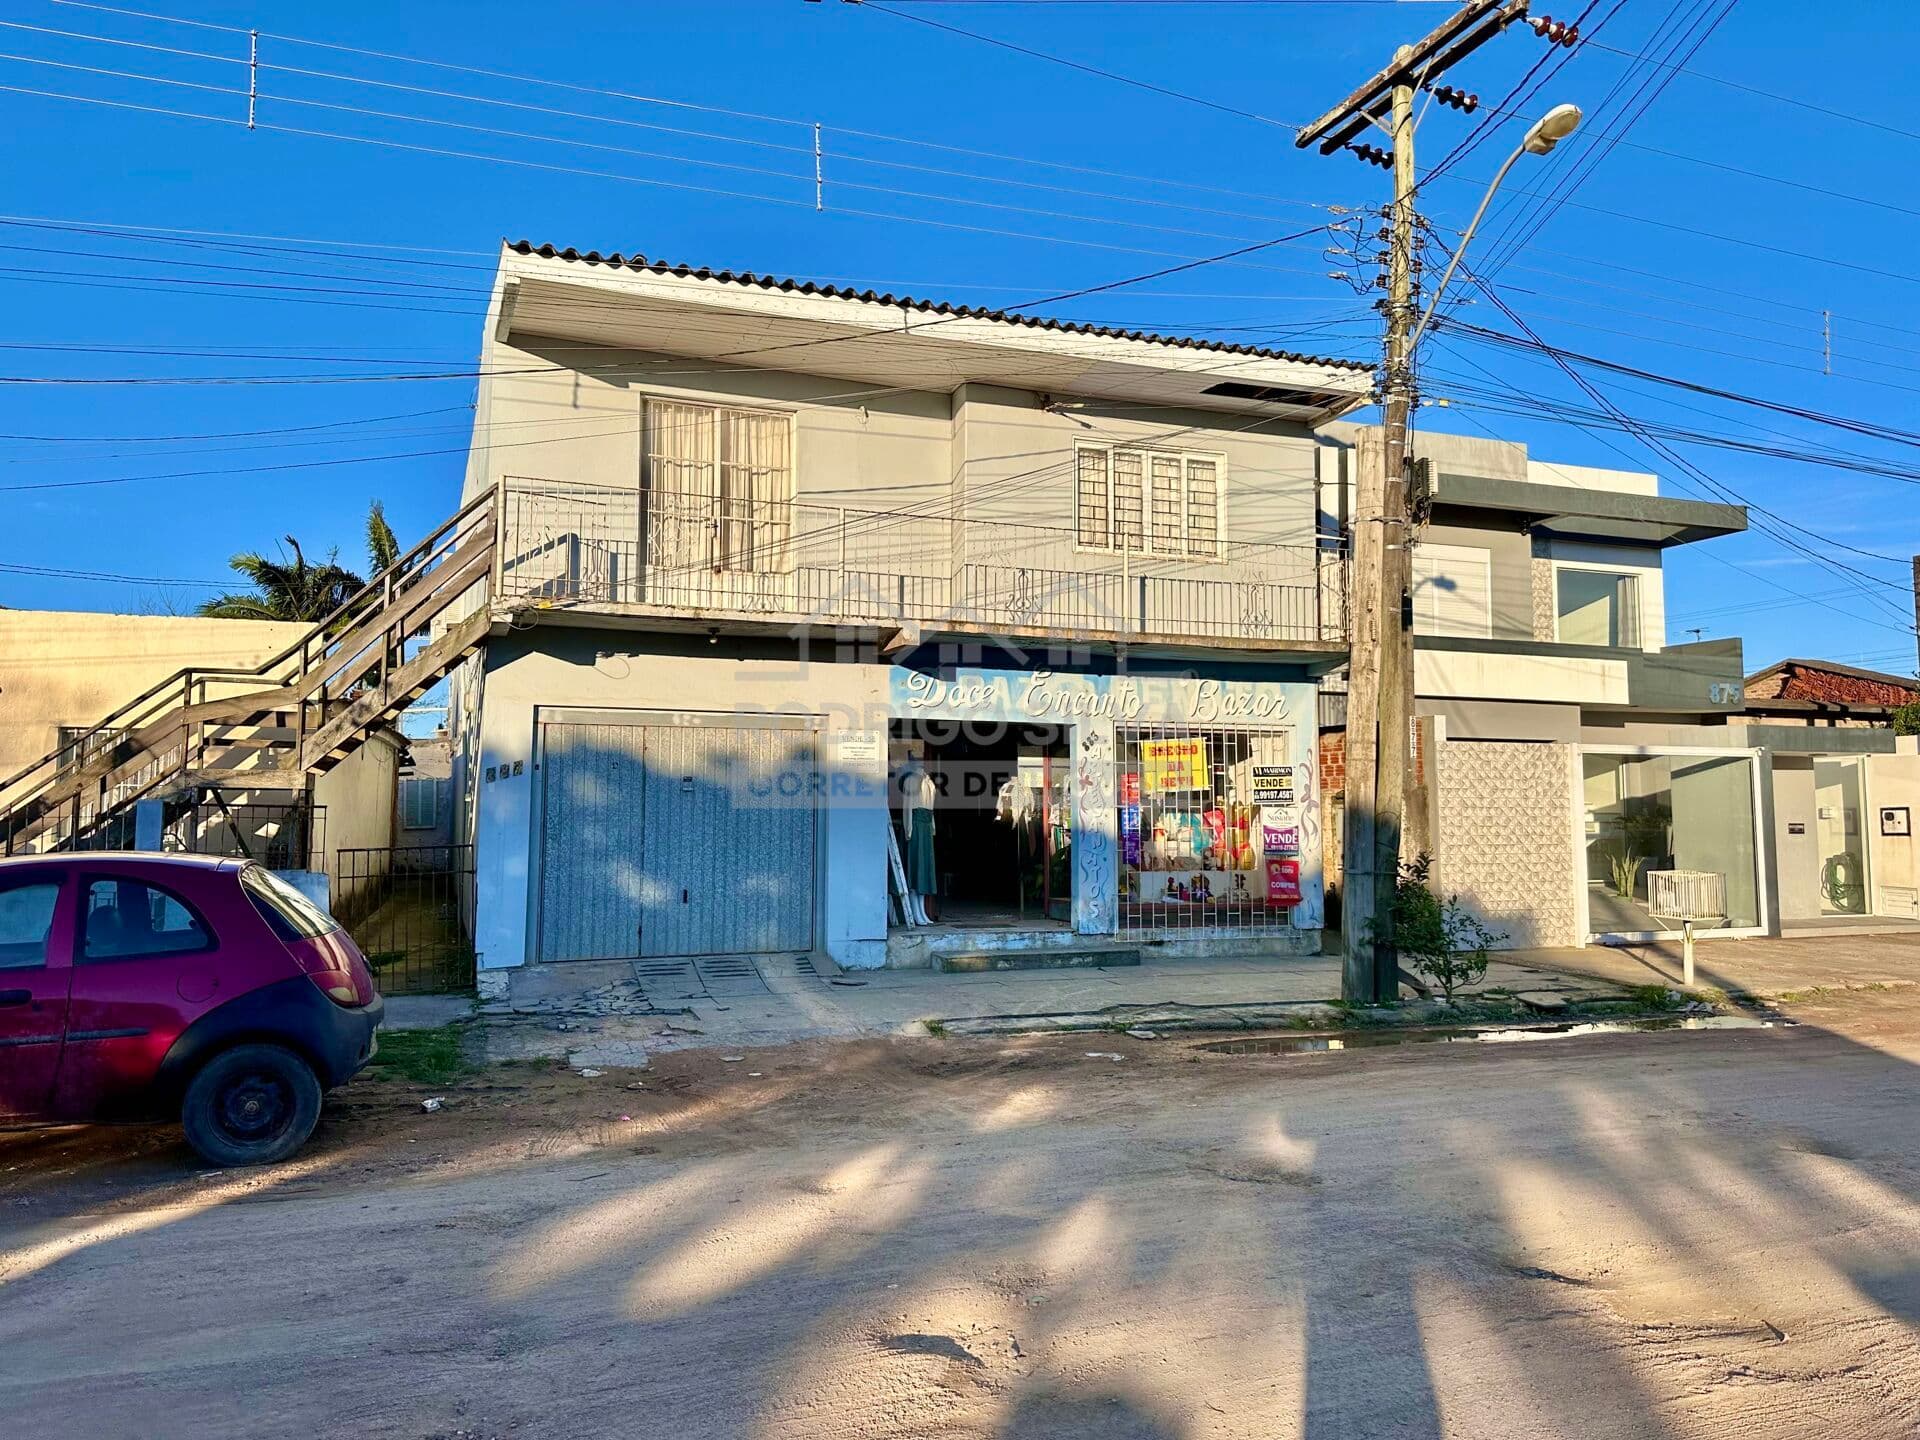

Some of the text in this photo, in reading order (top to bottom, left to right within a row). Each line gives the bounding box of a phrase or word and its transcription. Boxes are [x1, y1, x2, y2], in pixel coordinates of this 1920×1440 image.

[906, 668, 996, 709] Doce
[1023, 665, 1144, 721] Encanto
[1186, 676, 1290, 722] Bazar
[1709, 682, 1740, 705] 875
[1254, 778, 1284, 788] VENDE
[1264, 833, 1298, 844] VENDE
